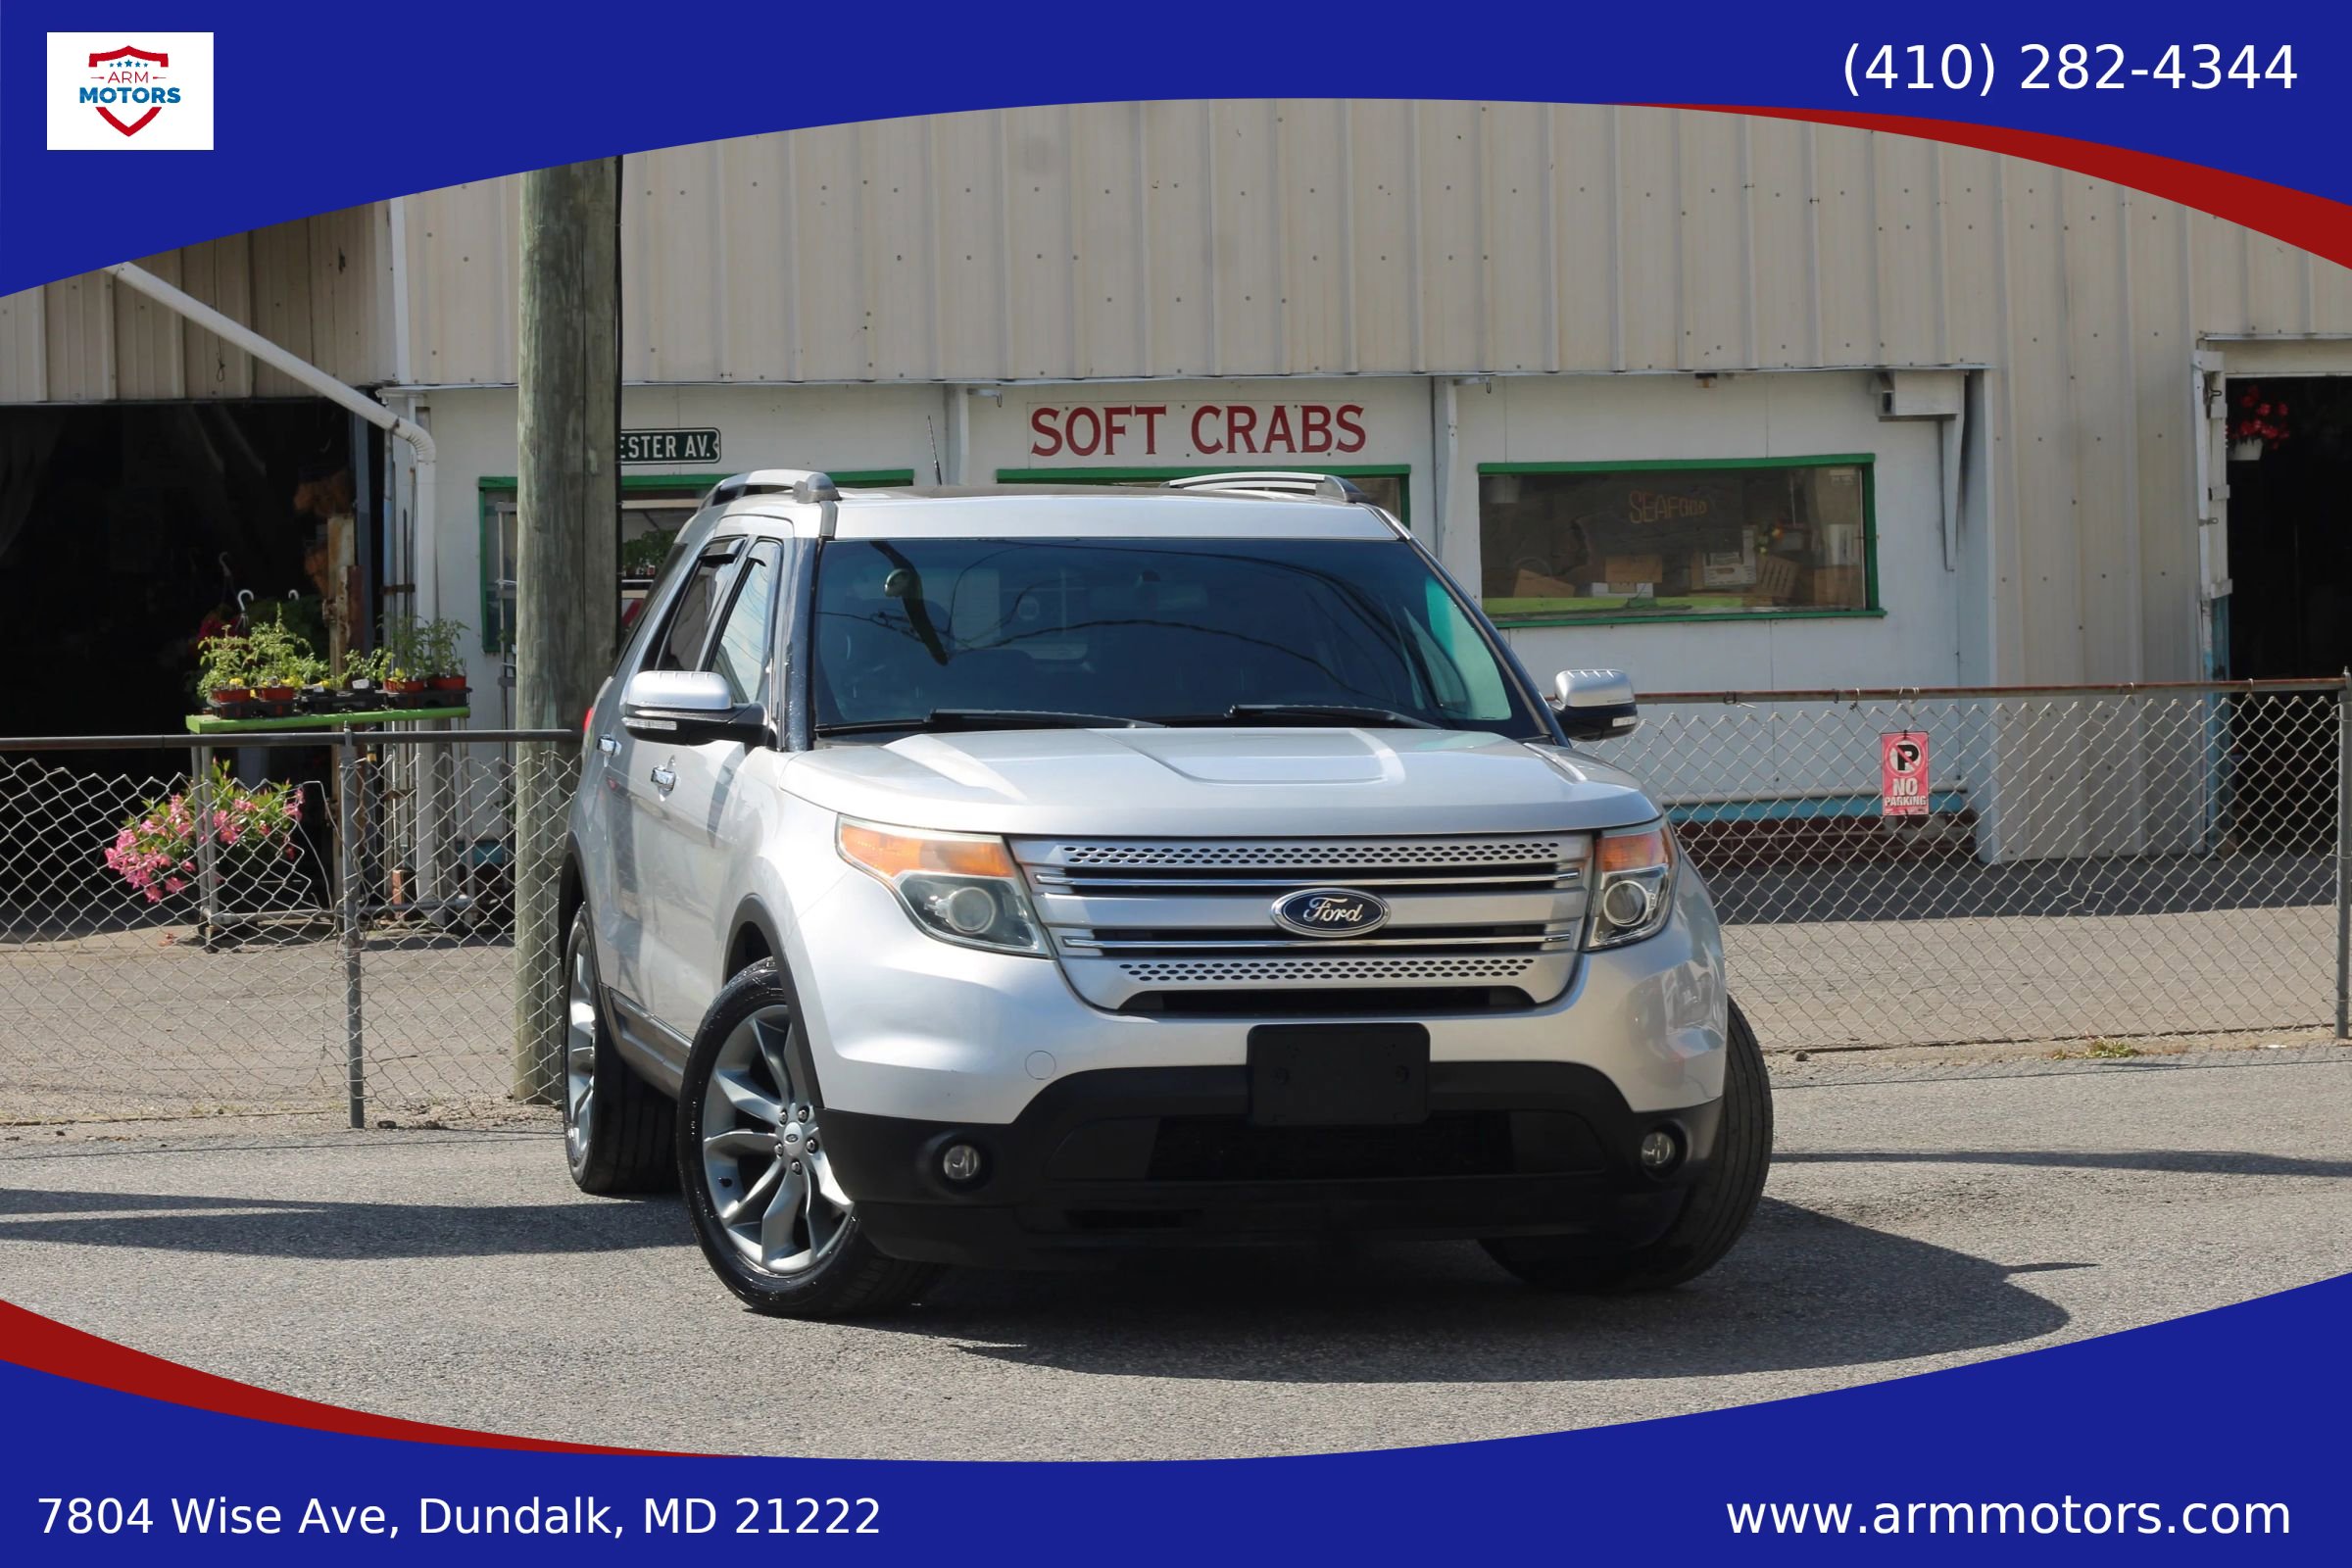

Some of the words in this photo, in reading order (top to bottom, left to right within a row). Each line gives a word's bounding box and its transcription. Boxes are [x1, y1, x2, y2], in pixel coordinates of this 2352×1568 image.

[1031, 405, 1167, 458] SOFT
[1191, 403, 1367, 456] CRABS
[684, 434, 710, 458] AV.
[1892, 777, 1918, 797] NO
[1884, 795, 1927, 807] PARKING
[1302, 897, 1364, 923] Ford
